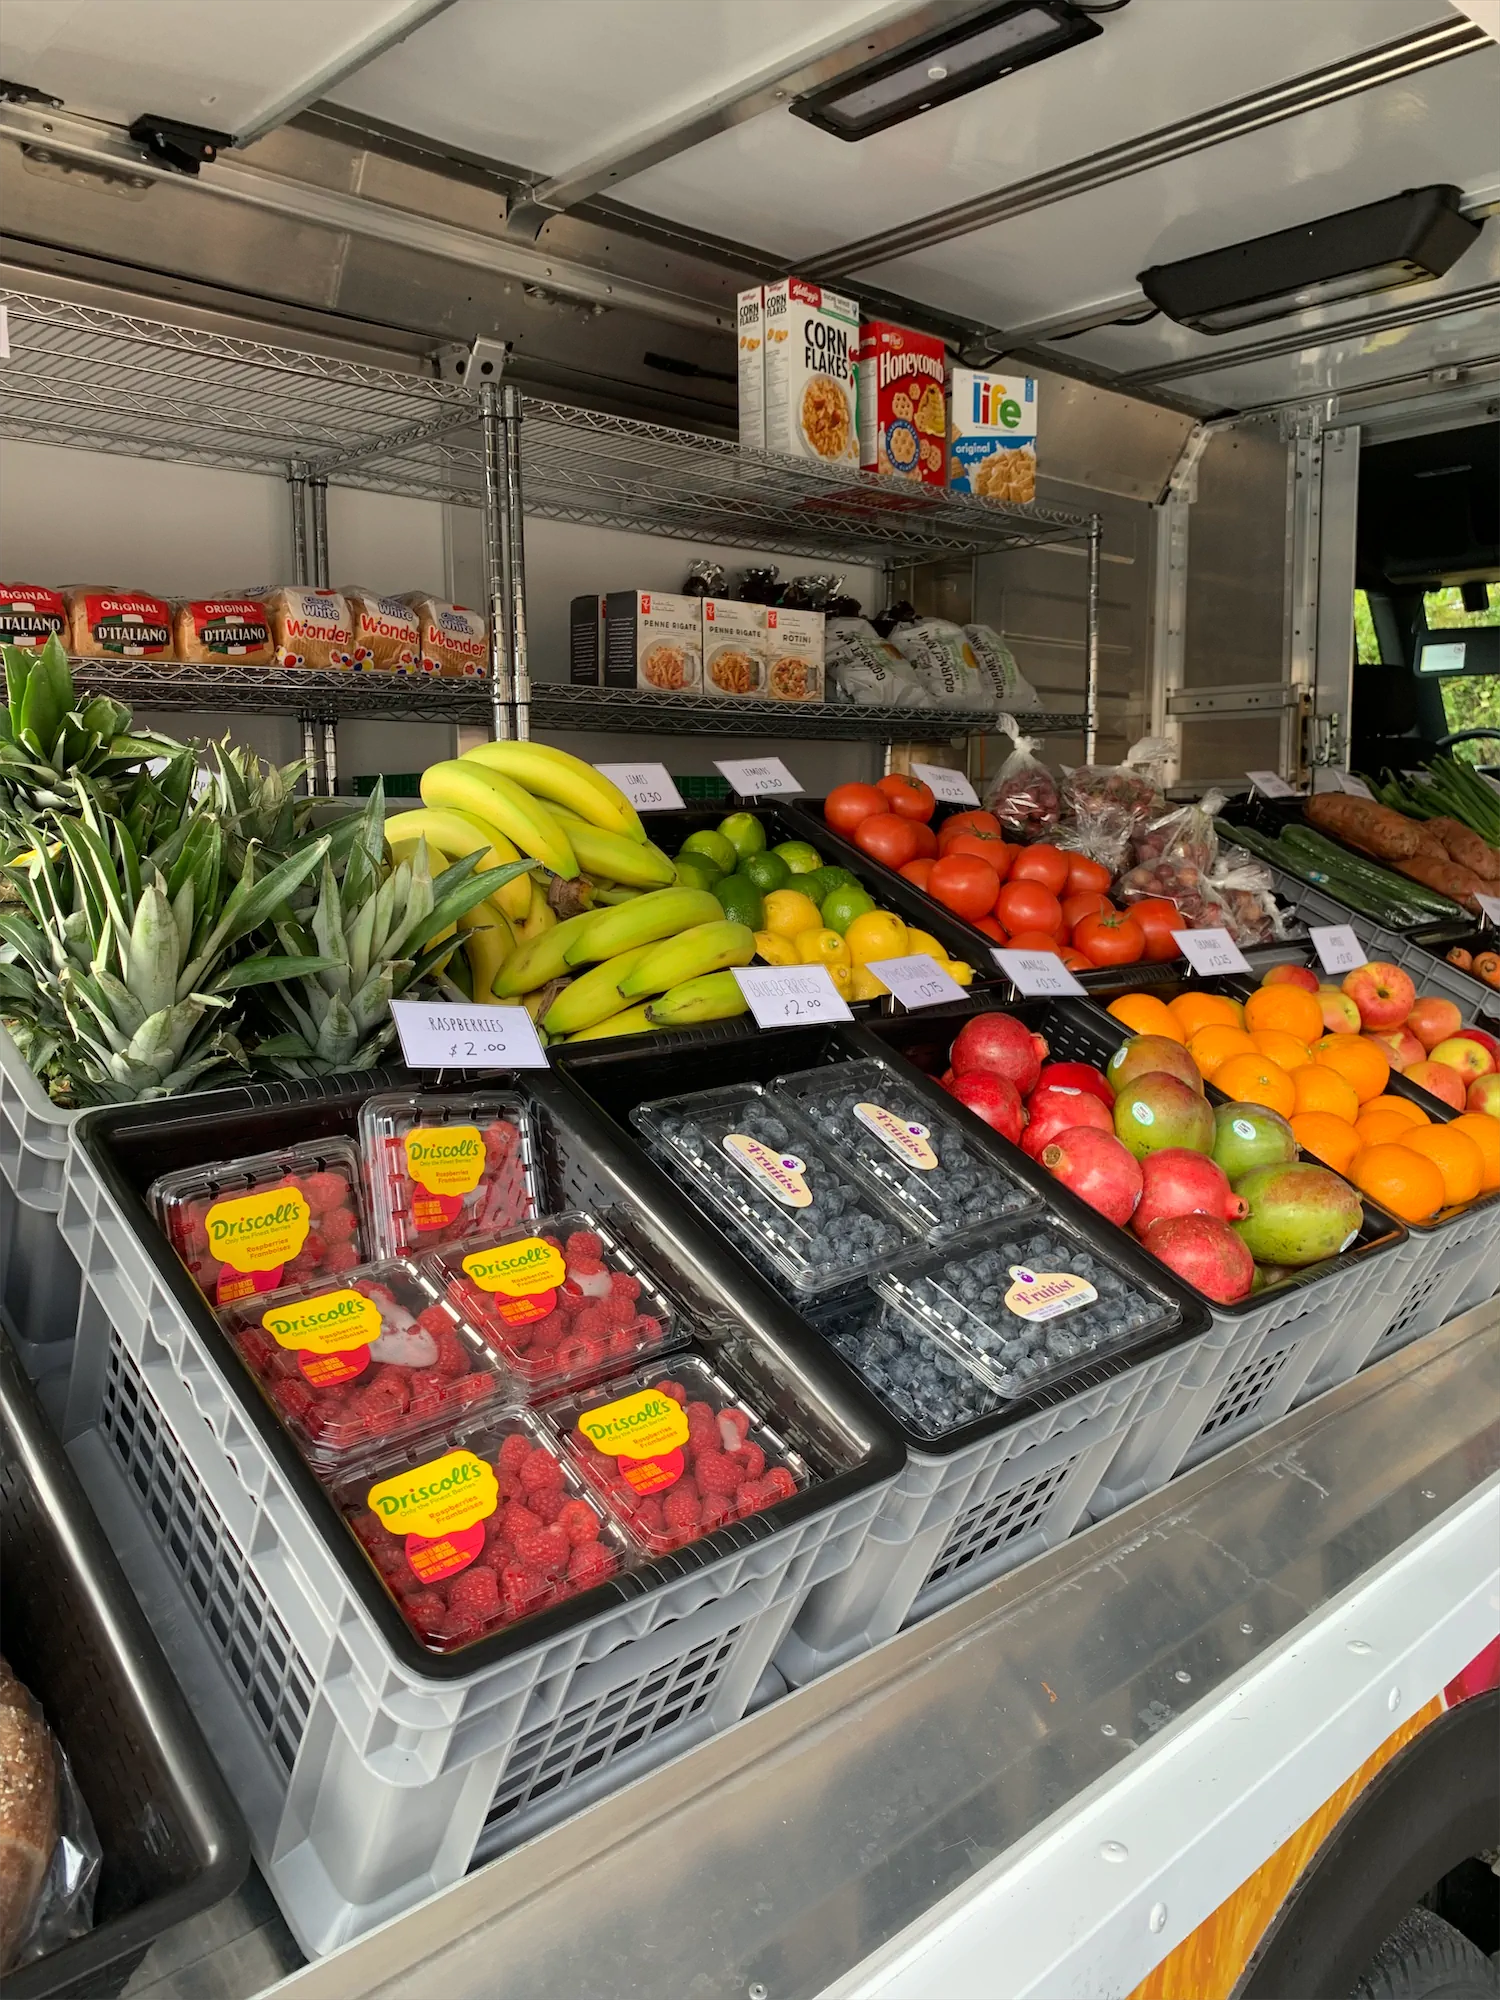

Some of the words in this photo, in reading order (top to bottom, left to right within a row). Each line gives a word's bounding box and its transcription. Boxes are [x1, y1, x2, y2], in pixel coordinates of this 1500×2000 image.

[766, 293, 787, 309] CORN
[792, 283, 818, 304] Kellogg's
[740, 302, 759, 318] CORN
[767, 305, 787, 318] FLAKES
[740, 315, 759, 327] FLAKES
[805, 320, 847, 358] CORN
[805, 346, 848, 380] FLAKES
[879, 350, 944, 389] Honeycomb
[973, 382, 1021, 428] life
[955, 442, 990, 456] original
[0, 590, 51, 601] RIGINAL
[101, 600, 158, 613] ORIGINAL
[204, 604, 257, 614] ORIGINAL
[302, 603, 340, 621] White
[378, 602, 414, 622] White
[0, 616, 61, 632] ITALIANO
[286, 618, 352, 645] Wonder
[360, 613, 420, 645] Wonder
[439, 618, 475, 635] White
[644, 619, 670, 629] PENNE
[672, 622, 697, 631] RIGATE
[709, 626, 734, 635] PENNE
[736, 628, 761, 638] RIGATE
[98, 627, 167, 642] D'ITALIANO
[204, 628, 266, 642] D'ITALIANO
[429, 624, 486, 657] Wonder
[782, 634, 812, 644] ROTINI
[745, 977, 821, 998] BLUEBERRIES
[428, 1016, 504, 1033] RASPBERRIES
[876, 1110, 928, 1158] Fruitist
[409, 1139, 480, 1160] Driscoll's
[747, 1142, 802, 1194] Fruitist
[210, 1202, 300, 1240] Driscoll's
[225, 1237, 239, 1245] Only
[251, 1229, 270, 1238] Finest
[270, 1224, 291, 1233] Berries
[246, 1238, 289, 1253] Raspberries
[249, 1244, 291, 1259] Framboises
[469, 1246, 551, 1278] Driscoll's
[1012, 1279, 1075, 1305] Fruitist
[270, 1299, 365, 1335] Driscoll's
[318, 1324, 364, 1340] Raspberries
[325, 1329, 369, 1345] Framboises
[586, 1399, 671, 1439] Driscoll's
[632, 1425, 673, 1445] Raspberries
[640, 1430, 678, 1449] Framboises
[376, 1461, 482, 1516] Driscoll's
[399, 1507, 417, 1518] Only
[429, 1492, 451, 1505] Finest
[451, 1482, 476, 1496] Berries
[428, 1494, 478, 1519] Raspberries
[435, 1500, 484, 1525] Framboises
